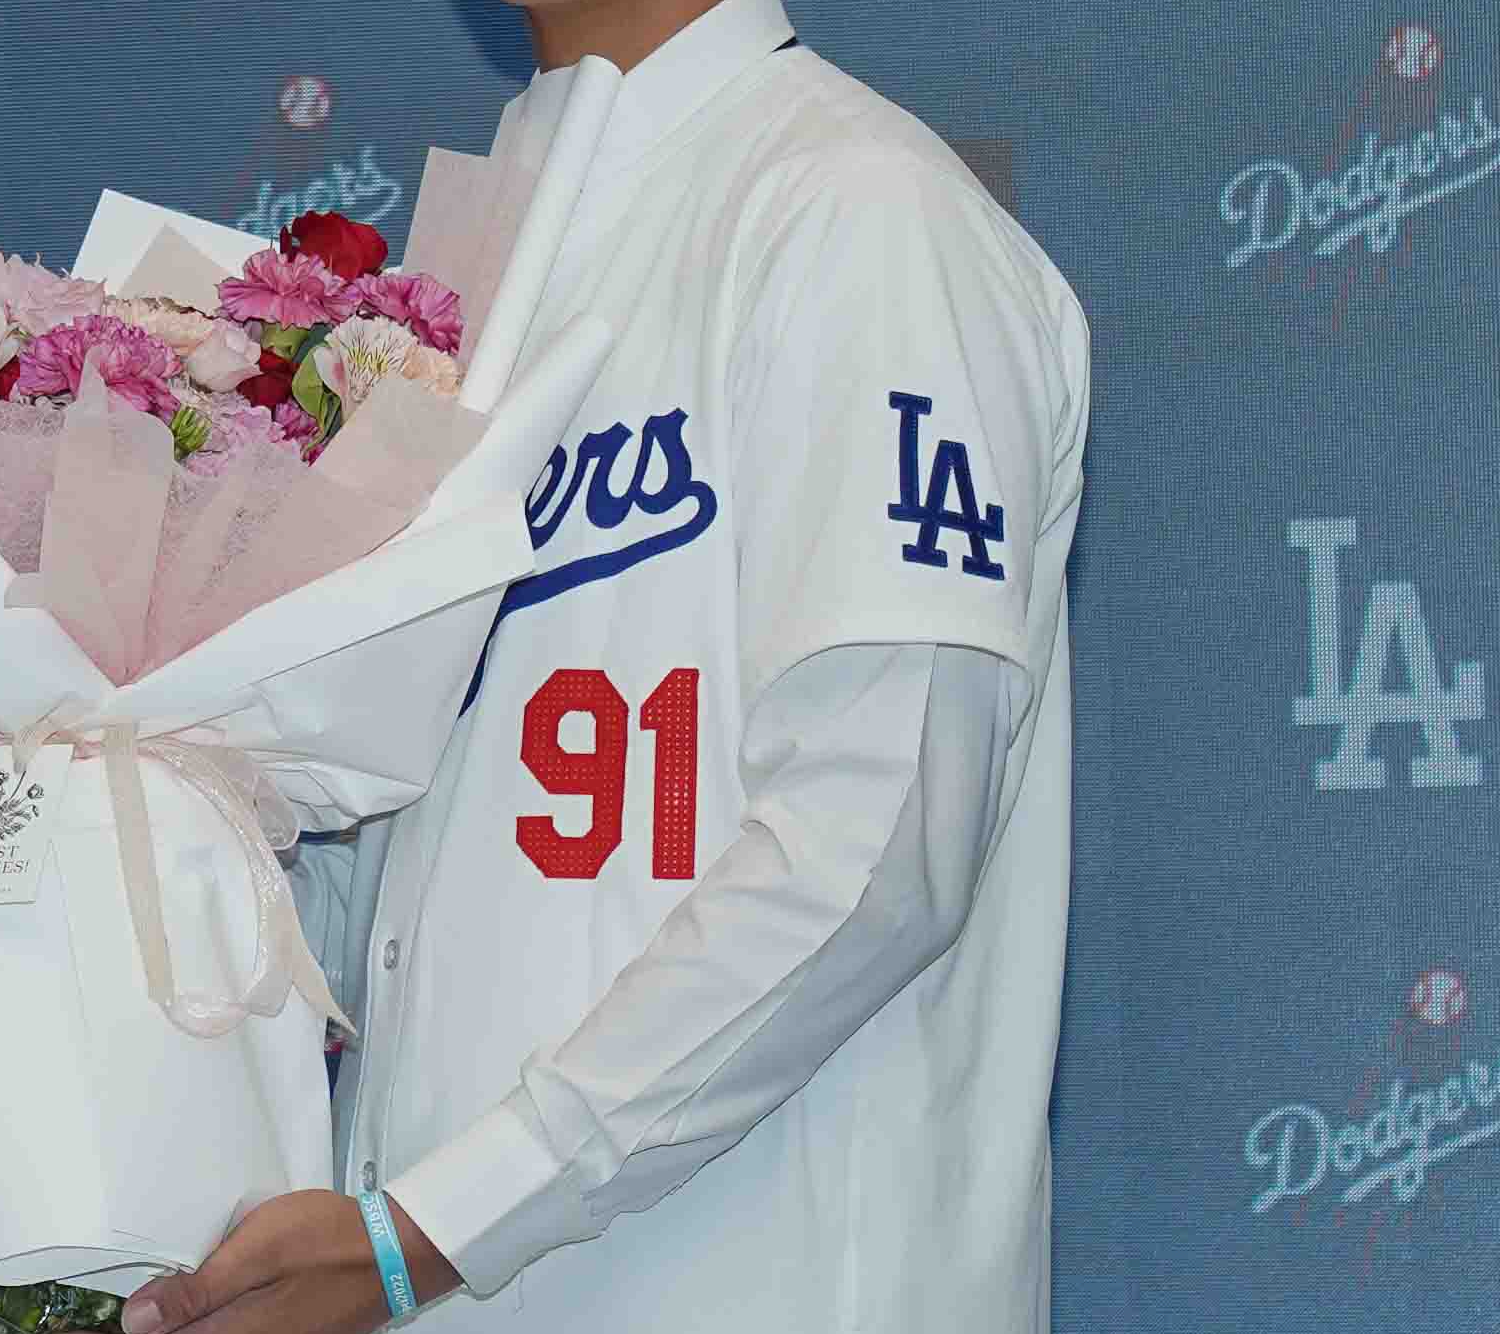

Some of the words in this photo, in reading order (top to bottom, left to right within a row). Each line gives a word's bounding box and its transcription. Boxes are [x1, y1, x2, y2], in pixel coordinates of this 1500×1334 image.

[1220, 98, 1500, 268] Dodgers
[888, 390, 1004, 580] LA
[1288, 517, 1485, 791] LA
[516, 668, 699, 880] 91
